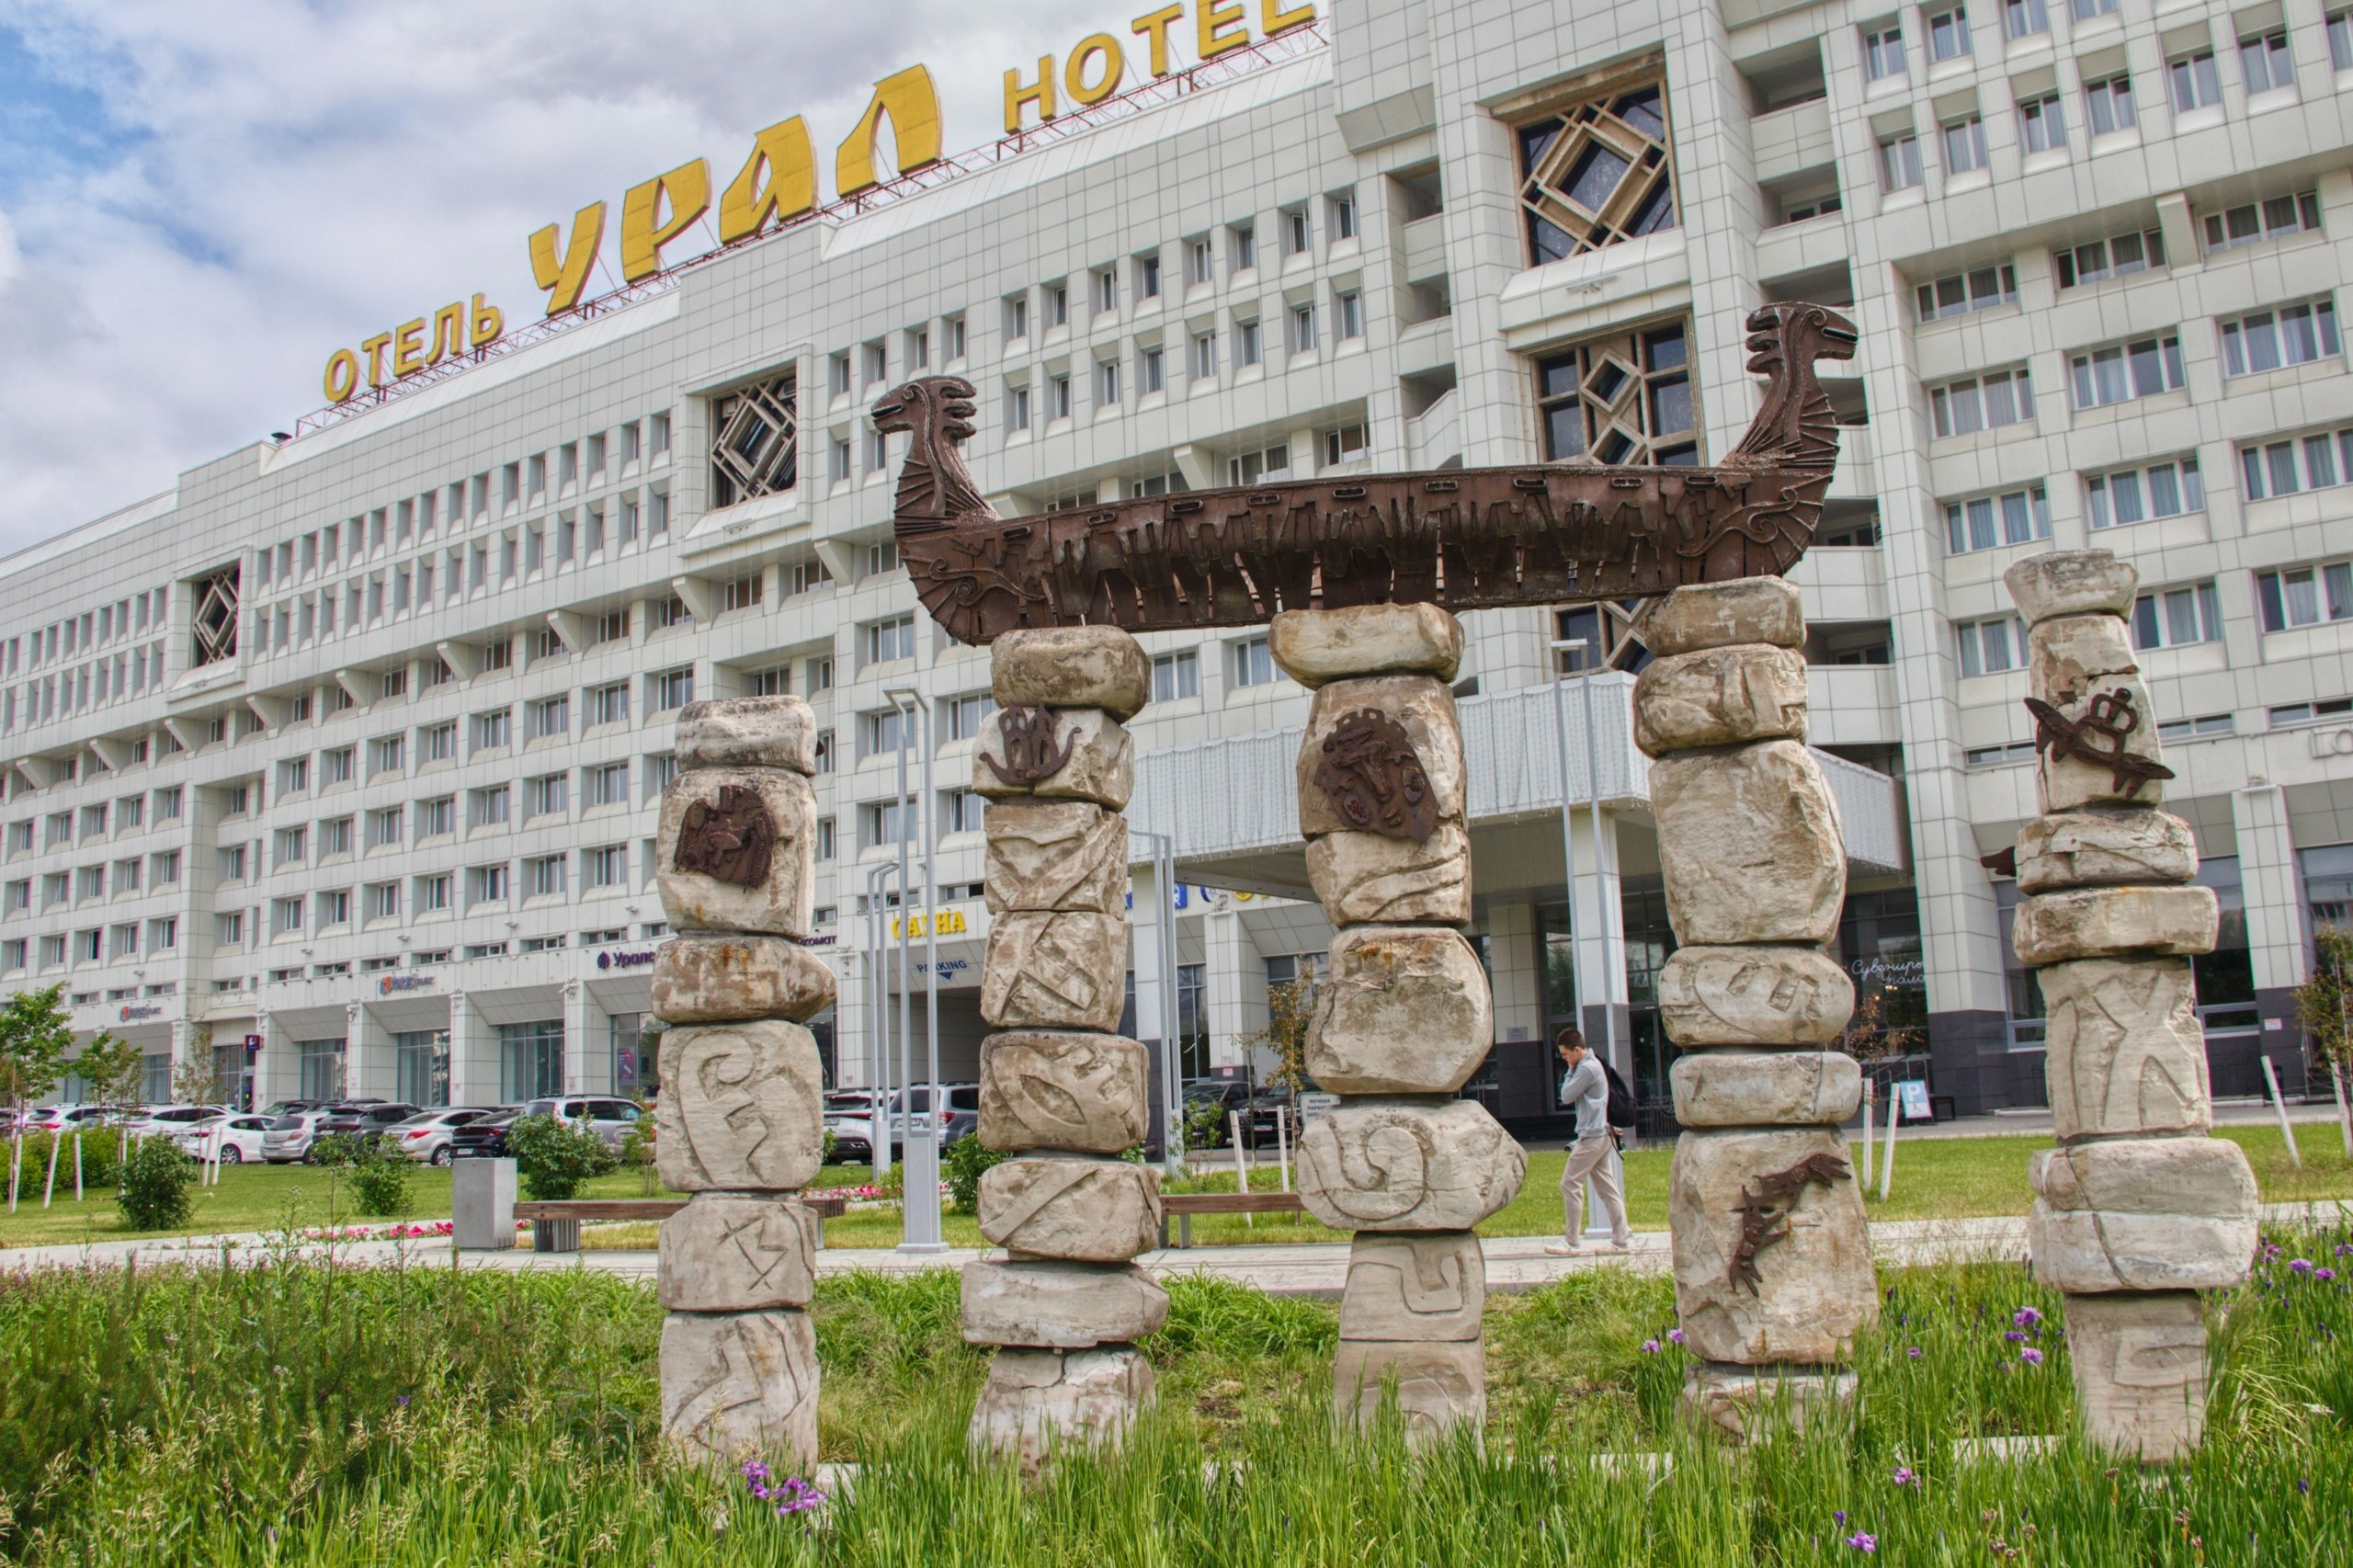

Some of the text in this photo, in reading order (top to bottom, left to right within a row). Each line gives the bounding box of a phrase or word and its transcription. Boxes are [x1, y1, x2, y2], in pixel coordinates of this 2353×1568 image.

[1004, 0, 1316, 135] HOTEL
[324, 62, 943, 403] ОТЕЛЬ УРАЛ
[916, 960, 967, 972] PKING
[1907, 1084, 1921, 1102] P
